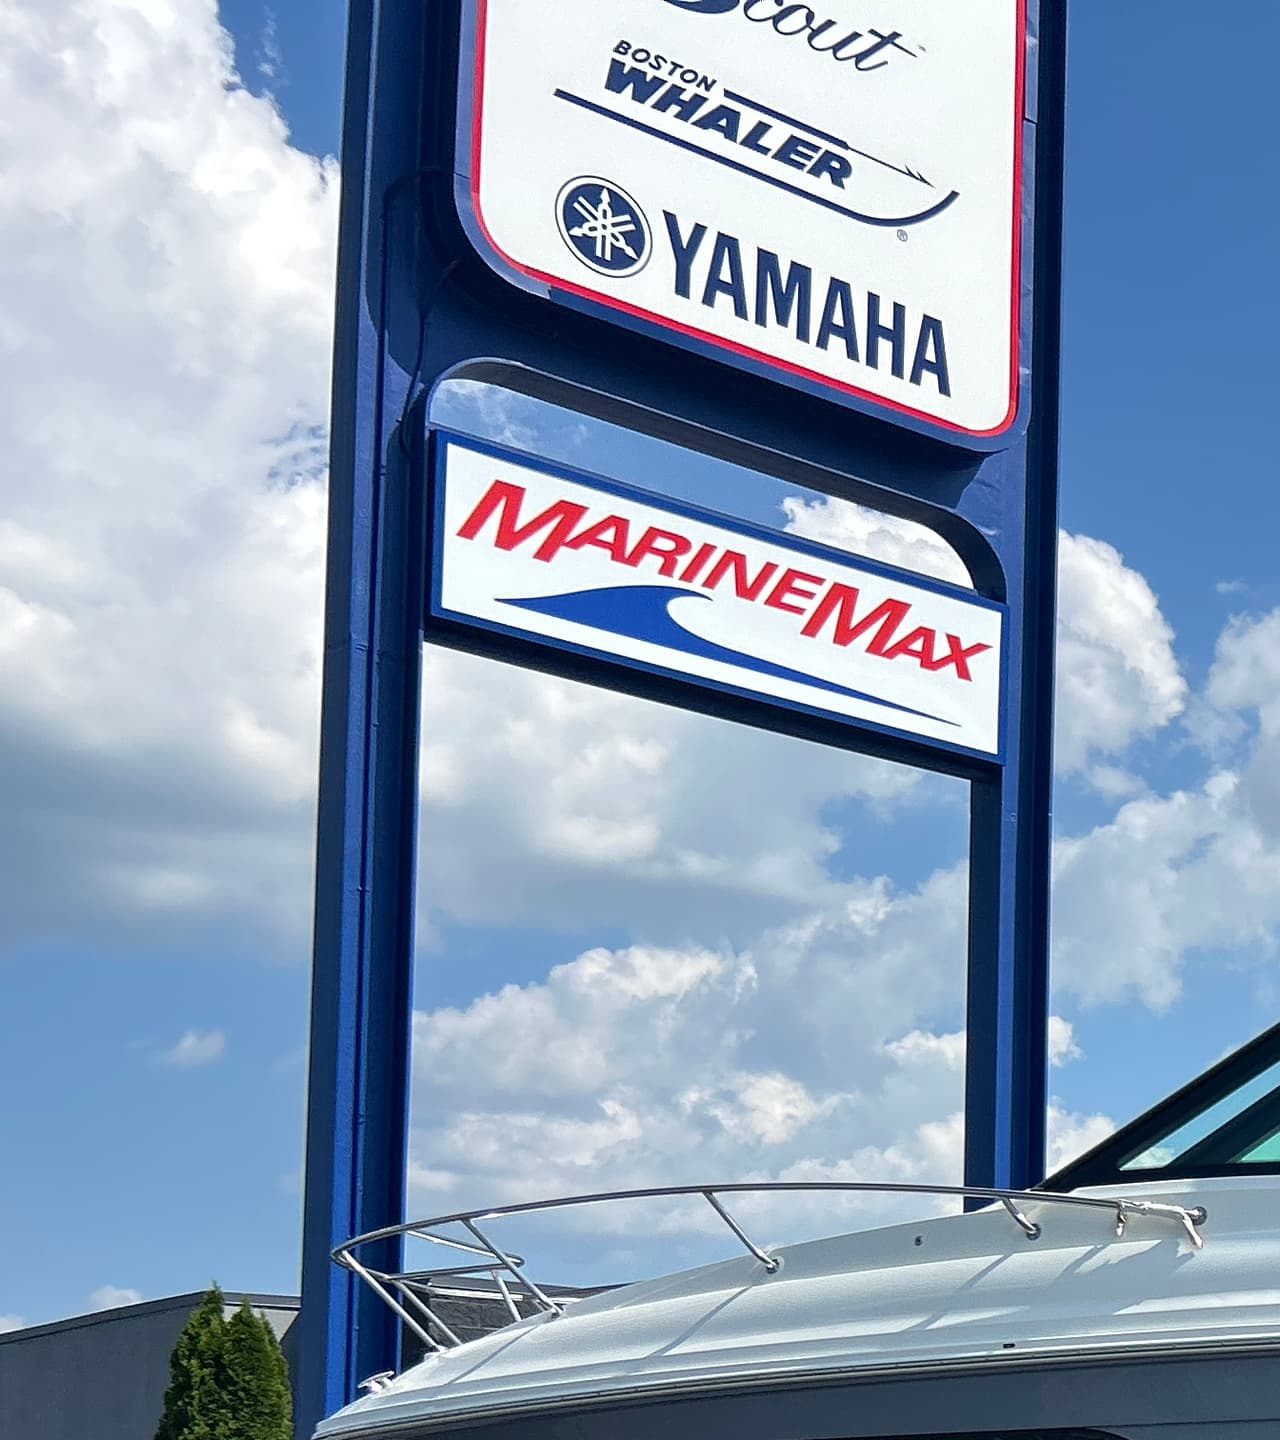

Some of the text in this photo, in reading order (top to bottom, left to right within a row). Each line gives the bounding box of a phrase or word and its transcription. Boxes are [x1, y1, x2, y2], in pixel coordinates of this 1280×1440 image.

[604, 57, 853, 190] WHALER
[612, 39, 717, 92] BOSTON
[662, 210, 951, 397] YAMAHA
[457, 480, 993, 682] MARINEMAX
